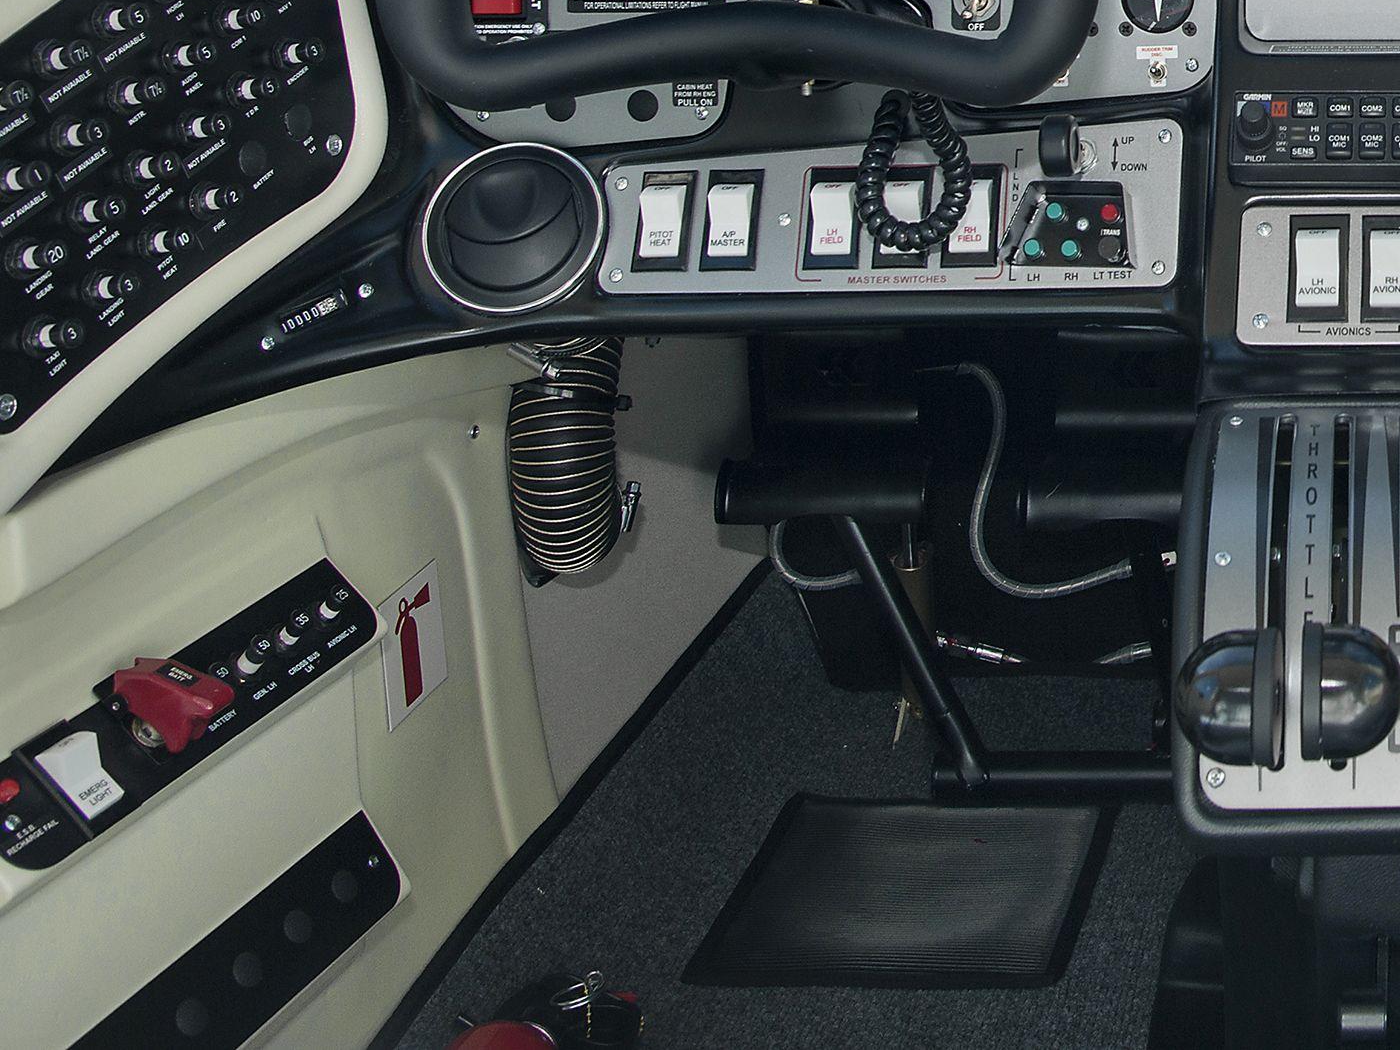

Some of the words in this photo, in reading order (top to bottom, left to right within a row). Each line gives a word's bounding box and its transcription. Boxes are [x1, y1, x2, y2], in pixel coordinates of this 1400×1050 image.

[968, 23, 984, 31] OFF
[48, 89, 66, 104] NOT
[678, 99, 698, 107] PULL
[1329, 104, 1351, 112] COM1
[1361, 104, 1383, 112] COM2
[957, 234, 981, 242] FIELD
[1027, 274, 1040, 282] LH
[1064, 273, 1078, 281] RH
[1094, 272, 1106, 280] LT
[1108, 271, 1131, 279] TEST
[893, 276, 946, 284] SWITCHES
[1311, 278, 1324, 286] LH
[1299, 286, 1336, 295] AVIONIC
[1325, 326, 1371, 336] AVIONICS
[207, 709, 237, 732] BATTERY
[89, 787, 113, 806] LIGHT
